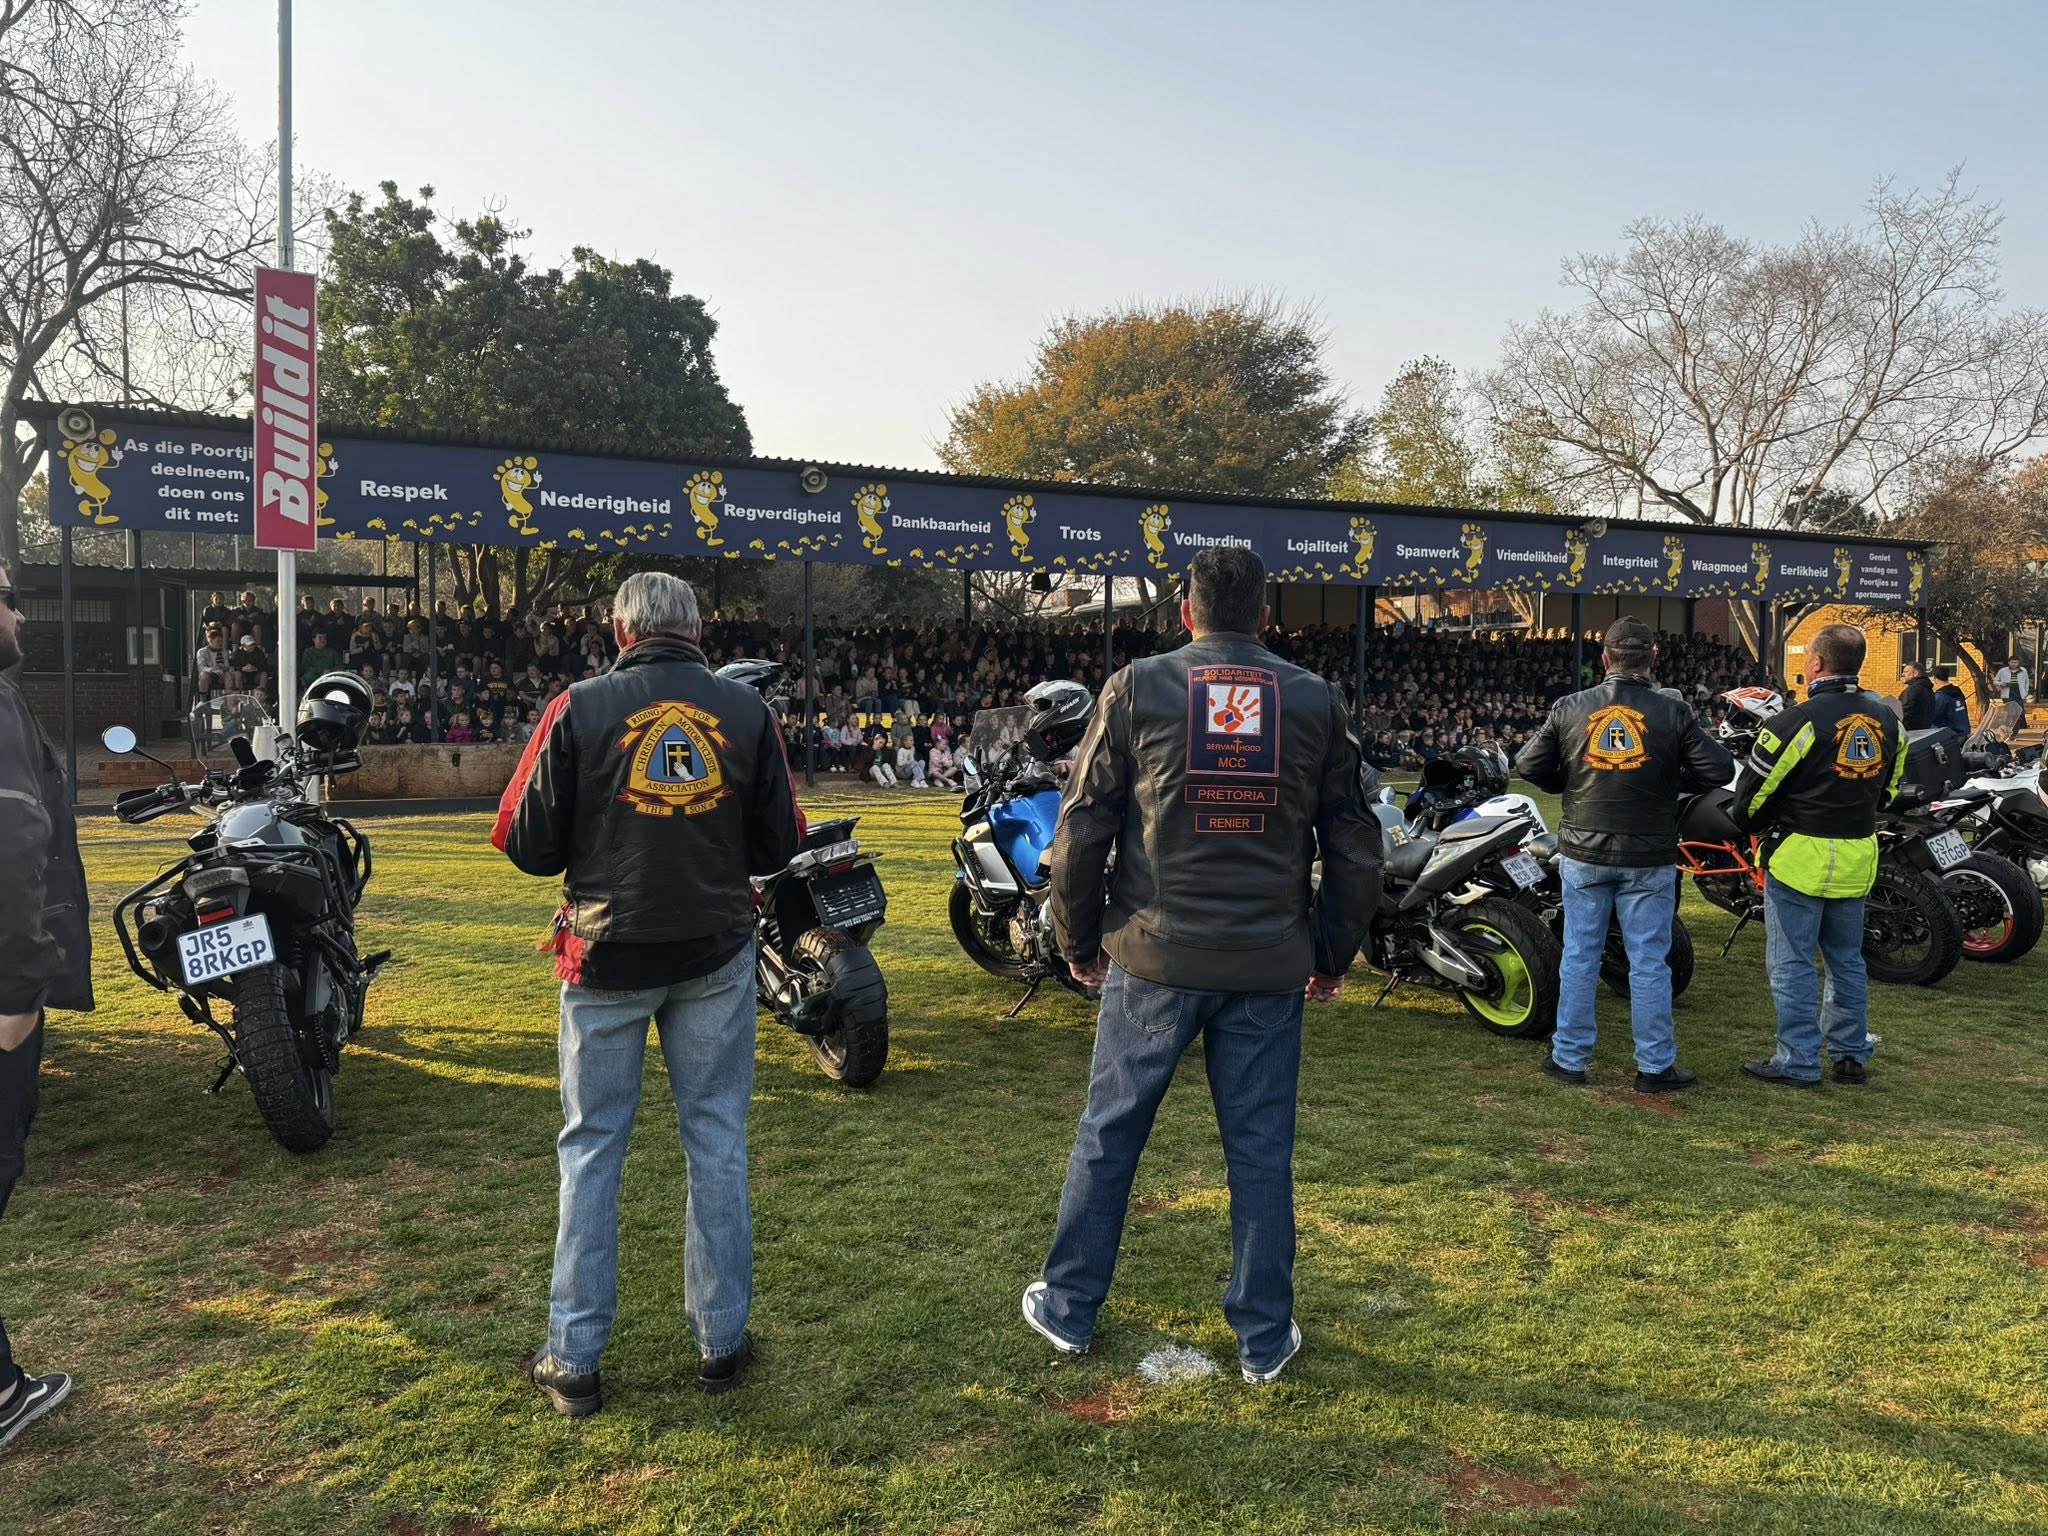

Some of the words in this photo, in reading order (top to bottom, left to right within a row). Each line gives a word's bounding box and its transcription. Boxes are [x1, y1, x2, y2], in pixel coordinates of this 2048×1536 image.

[262, 294, 310, 350] it
[262, 343, 310, 525] Build
[123, 438, 149, 452] As
[155, 441, 185, 454] die
[151, 462, 250, 483] deelneem,
[158, 485, 205, 499] doen
[211, 490, 245, 501] ons
[360, 479, 449, 502] Respek
[540, 491, 671, 514] Nederigheid
[165, 507, 191, 520] dit
[197, 510, 239, 523] met:
[724, 503, 841, 524] Regverdigheid
[891, 515, 991, 534] Dankbaarheid
[1059, 525, 1102, 541] Trots
[1173, 532, 1252, 550] Volharding
[1287, 538, 1349, 555] Lojaliteit
[1395, 544, 1460, 560] Spanwerk
[1496, 549, 1568, 564] Vriendelikheid
[1602, 554, 1659, 569] Integriteit
[1869, 552, 1891, 562] Geniet
[1692, 560, 1748, 574] Waagmoed
[1780, 564, 1829, 578] Eerlikheid
[1860, 565, 1885, 576] vandag
[1859, 577, 1889, 588] Poortjies
[630, 709, 660, 725] RIDING
[692, 710, 711, 723] FOR
[636, 720, 668, 772] CHRISTIAN
[676, 717, 718, 774] MOTORCYCLISTS
[1218, 757, 1247, 769] MCC
[645, 780, 709, 792] ASSOCIATION
[1197, 790, 1266, 801] PRETORIA
[645, 805, 665, 815] THE
[1209, 818, 1250, 829] RENIER
[1929, 836, 1949, 854] CS7
[1938, 843, 1967, 866] 6TCGP
[185, 926, 232, 957] JR5
[188, 939, 267, 978] 8RKGP
